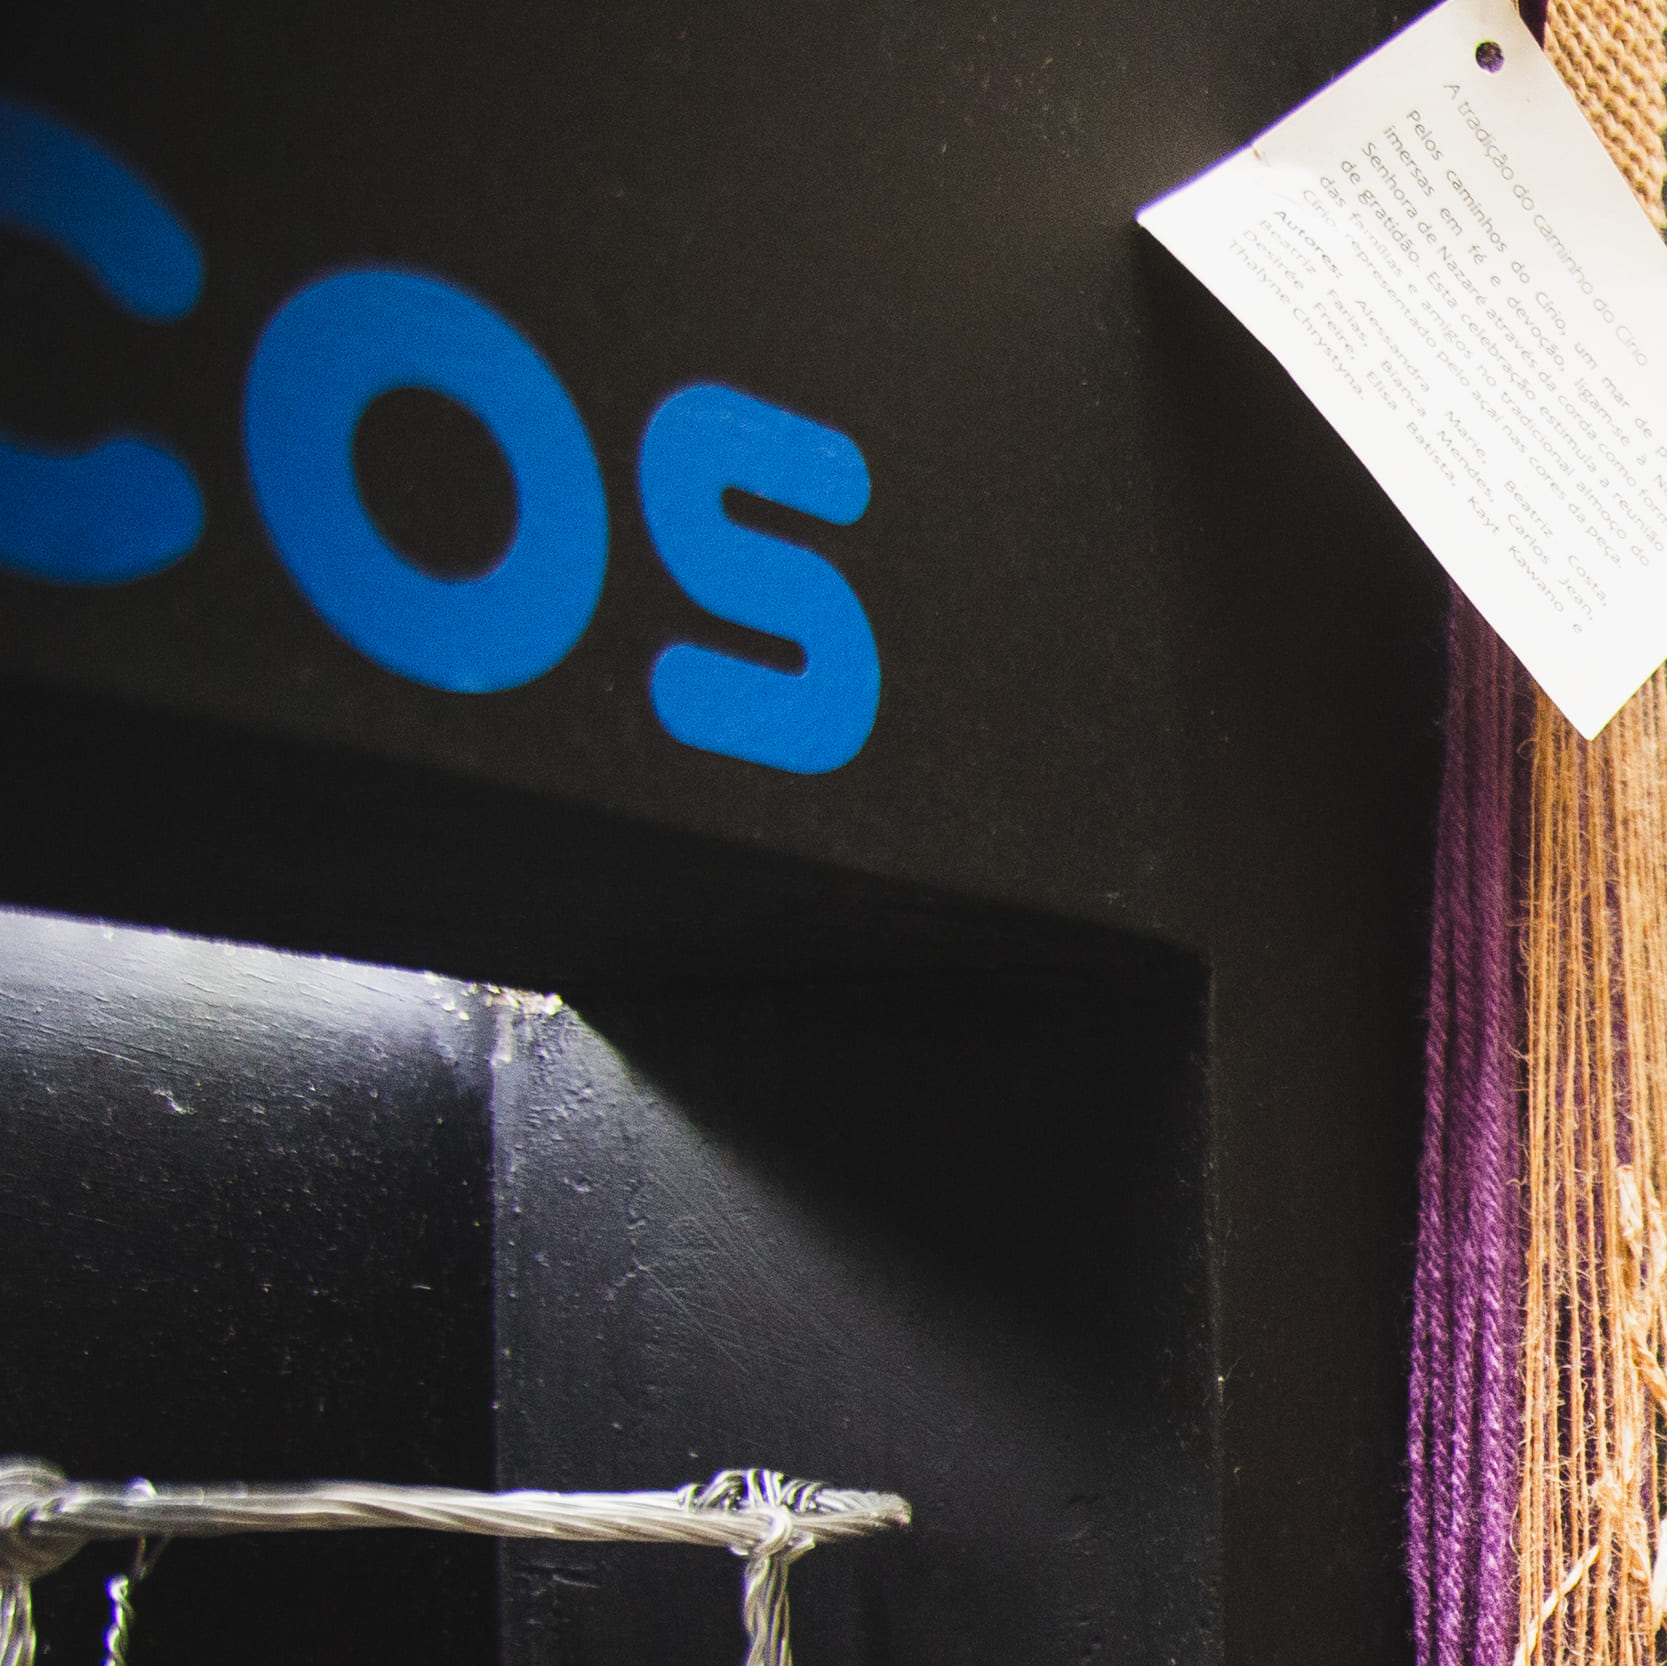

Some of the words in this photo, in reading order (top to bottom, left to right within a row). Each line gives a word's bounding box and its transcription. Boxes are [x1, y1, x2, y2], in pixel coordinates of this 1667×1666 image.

[1229, 239, 1290, 303] Thalyne
[1319, 176, 1345, 207] das
[1408, 283, 1417, 293] e
[1421, 301, 1471, 359] amigos
[1476, 364, 1495, 386] no
[1501, 391, 1574, 475] tradicional
[1576, 482, 1625, 539] almoço
[1630, 545, 1649, 566] do
[1340, 160, 1360, 184] de
[1357, 189, 1419, 267] gratidão.
[1426, 271, 1457, 308] Esta
[1461, 314, 1535, 399] celebração
[1539, 406, 1596, 472] estimula
[1599, 478, 1609, 487] a
[1612, 492, 1663, 551] reunião
[1361, 141, 1417, 218] Senhora
[1417, 221, 1436, 244] de
[1437, 245, 1487, 305] Nazaré
[1486, 309, 1536, 367] através
[1538, 371, 1556, 391] da
[1558, 395, 1596, 439] corda
[1598, 443, 1636, 486] como
[1383, 125, 1434, 196] imersas
[1440, 207, 1462, 236] em
[1468, 244, 1486, 264] fé
[1490, 275, 1500, 286] e
[1574, 377, 1629, 445] ligam-se
[1636, 454, 1646, 465] à
[1406, 109, 1443, 160] Pelos
[1445, 169, 1507, 252] caminhos
[1510, 260, 1529, 283] do
[1535, 291, 1565, 335] Círio,
[1574, 341, 1597, 369] um
[1601, 376, 1630, 407] mar
[1634, 417, 1652, 438] de
[1442, 83, 1460, 99] A
[1457, 100, 1513, 180] tradição
[1512, 184, 1534, 210] do
[1533, 213, 1593, 294] caminho
[1592, 298, 1614, 323] do
[1243, 229, 1303, 289] Desirée
[1366, 370, 1397, 410] Elisa
[1508, 545, 1563, 612] Kawano
[1572, 623, 1582, 633] e
[1259, 220, 1315, 273] Beatriz
[1380, 359, 1426, 416] Bianca
[1507, 513, 1549, 564] Carlos
[1273, 211, 1342, 278] Autores:
[1354, 300, 1429, 391] Alessandra
[1504, 479, 1552, 537] Beatriz
[1345, 234, 1436, 347] representado
[1435, 351, 1469, 386] pelo
[1471, 390, 1503, 422] açaí
[1501, 424, 1526, 453] nas
[1529, 456, 1565, 499] cores
[1568, 503, 1585, 523] da
[1585, 525, 1621, 567] peça.
